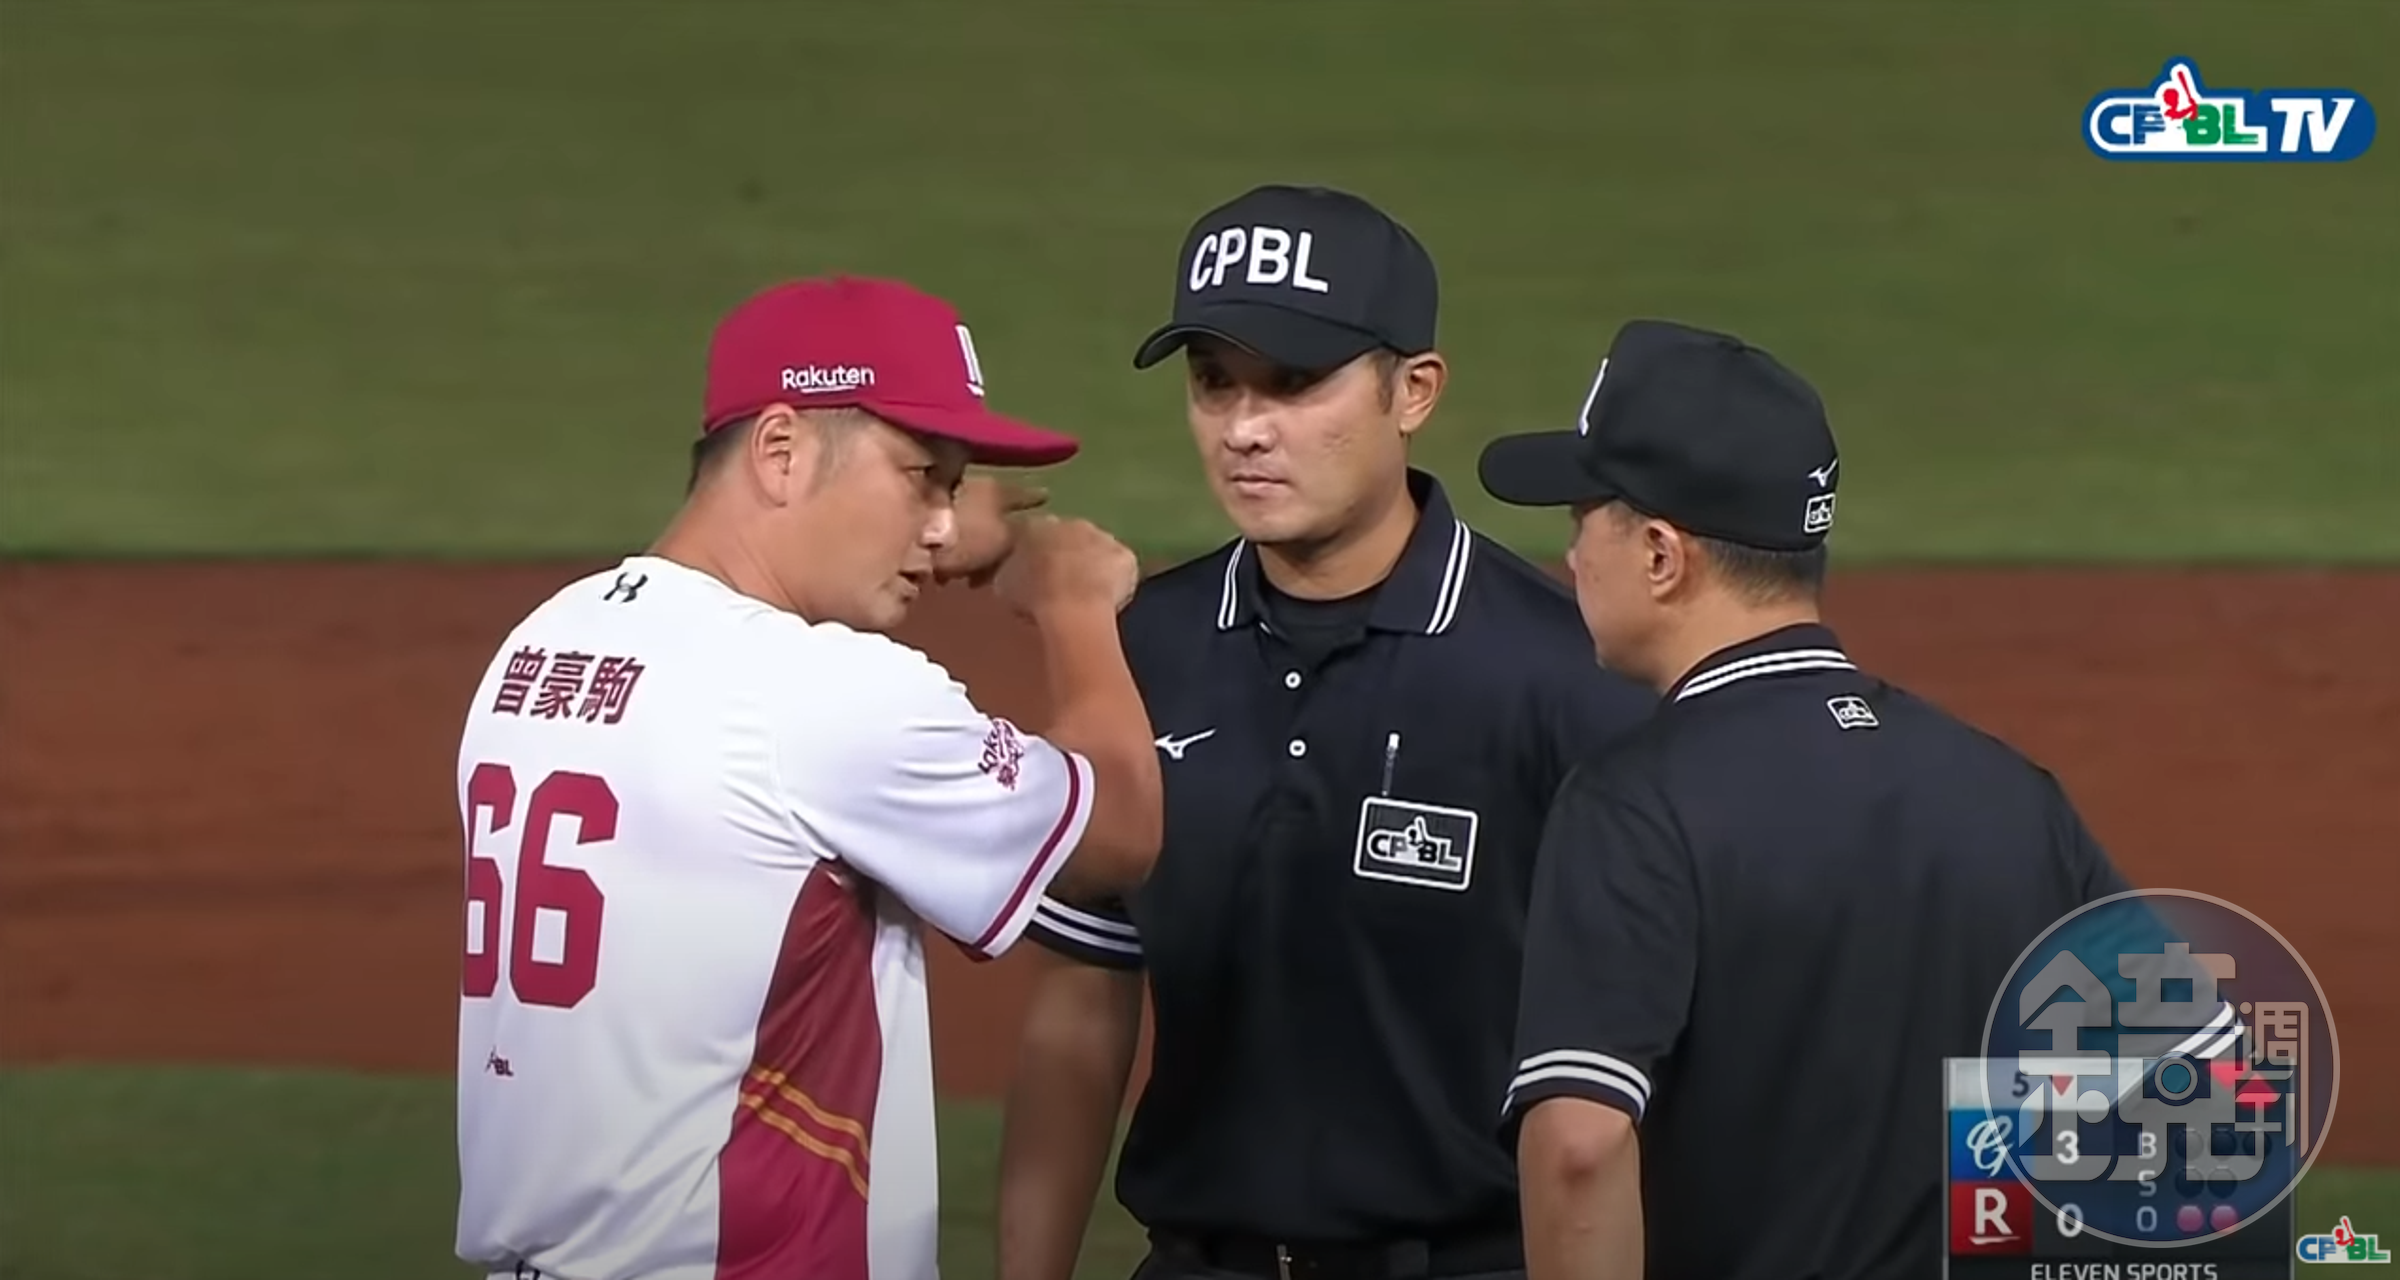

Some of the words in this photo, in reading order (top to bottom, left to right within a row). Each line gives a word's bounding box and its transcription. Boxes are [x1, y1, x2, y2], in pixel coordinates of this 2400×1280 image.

[1188, 225, 1329, 293] CPBL
[781, 365, 875, 391] Rakuten
[491, 644, 647, 725] 曾豪駒
[1369, 831, 1460, 869] CPBL
[462, 762, 620, 1010] 66
